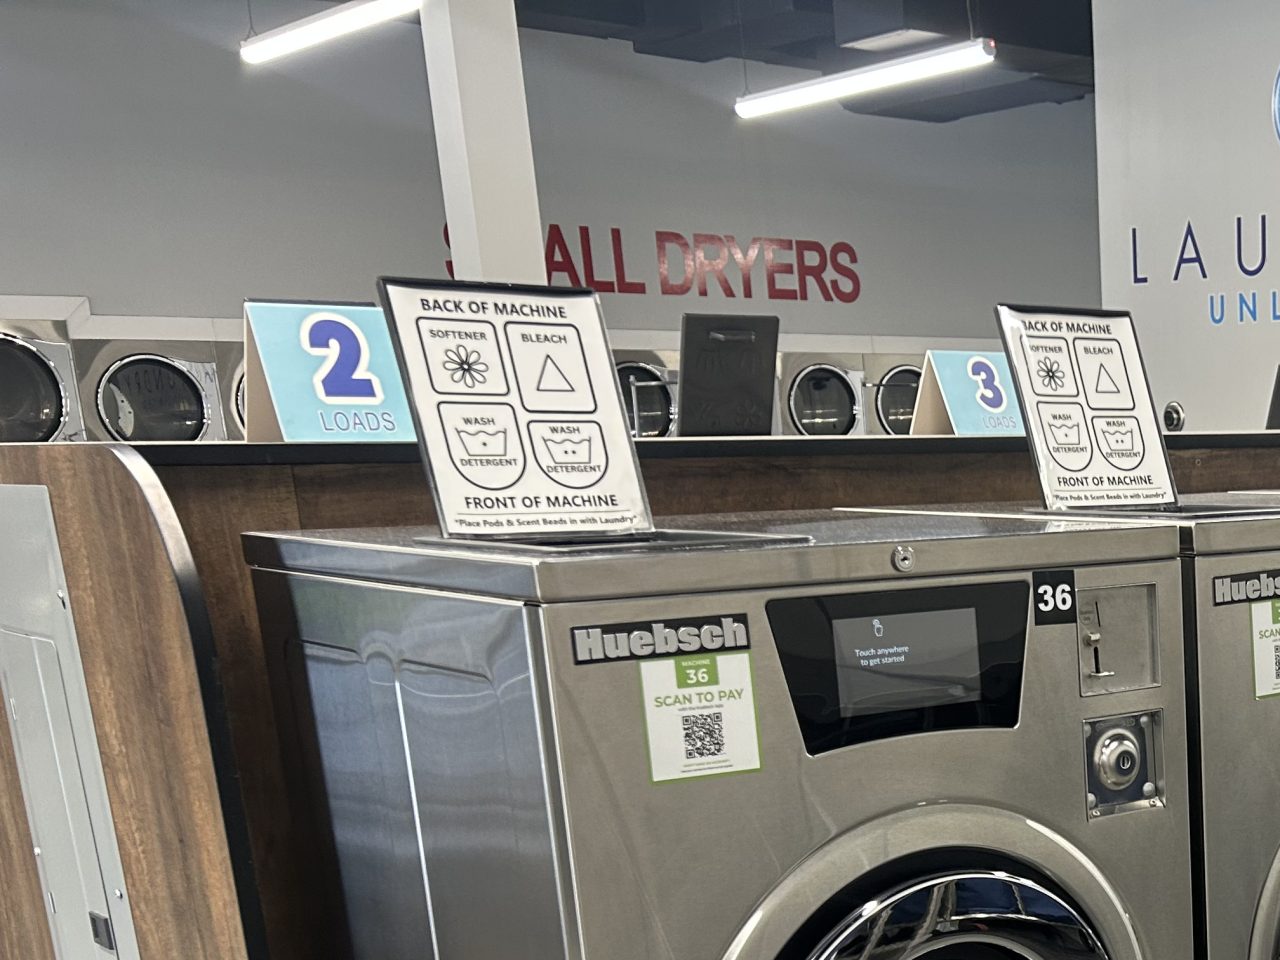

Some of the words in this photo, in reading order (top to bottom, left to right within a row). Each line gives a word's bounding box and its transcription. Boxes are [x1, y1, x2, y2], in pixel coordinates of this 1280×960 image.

[655, 230, 861, 304] DRYERS
[420, 298, 465, 314] BACK
[470, 301, 489, 314] OF
[494, 302, 568, 319] MACHINE
[1022, 320, 1048, 332] BACK
[1050, 321, 1063, 332] OF
[1066, 322, 1112, 335] MACHINE
[429, 329, 488, 341] SOFTENER
[521, 333, 567, 344] BLEACH
[1084, 347, 1113, 355] BLEACH
[306, 317, 379, 400] 2
[970, 359, 1005, 410] 3
[319, 411, 396, 431] LOADS
[463, 416, 496, 426] WASH
[983, 416, 1016, 429] LOADS
[1051, 413, 1072, 421] WASH
[549, 426, 580, 435] WASH
[460, 458, 518, 467] DETERGENT
[546, 465, 601, 473] DETERGENT
[1057, 476, 1089, 487] FRONT
[1092, 476, 1105, 486] OF
[1107, 475, 1153, 486] MACHINE
[464, 496, 516, 509] FRONT
[522, 496, 542, 509] OF
[547, 494, 618, 508] MACHINE
[483, 519, 504, 527] Pods
[517, 518, 540, 526] Scent
[542, 518, 567, 526] Beads
[569, 517, 577, 525] in
[580, 516, 597, 525] with
[1037, 583, 1073, 612] 36
[573, 617, 748, 661] Huebsch
[1258, 628, 1280, 639] SCAN
[854, 648, 876, 657] Touch
[877, 646, 909, 655] anywhere
[869, 658, 880, 666] get
[881, 655, 905, 664] started
[686, 668, 709, 684] 36
[654, 693, 692, 708] SCAN
[695, 691, 715, 703] TO
[718, 688, 744, 702] PAY
